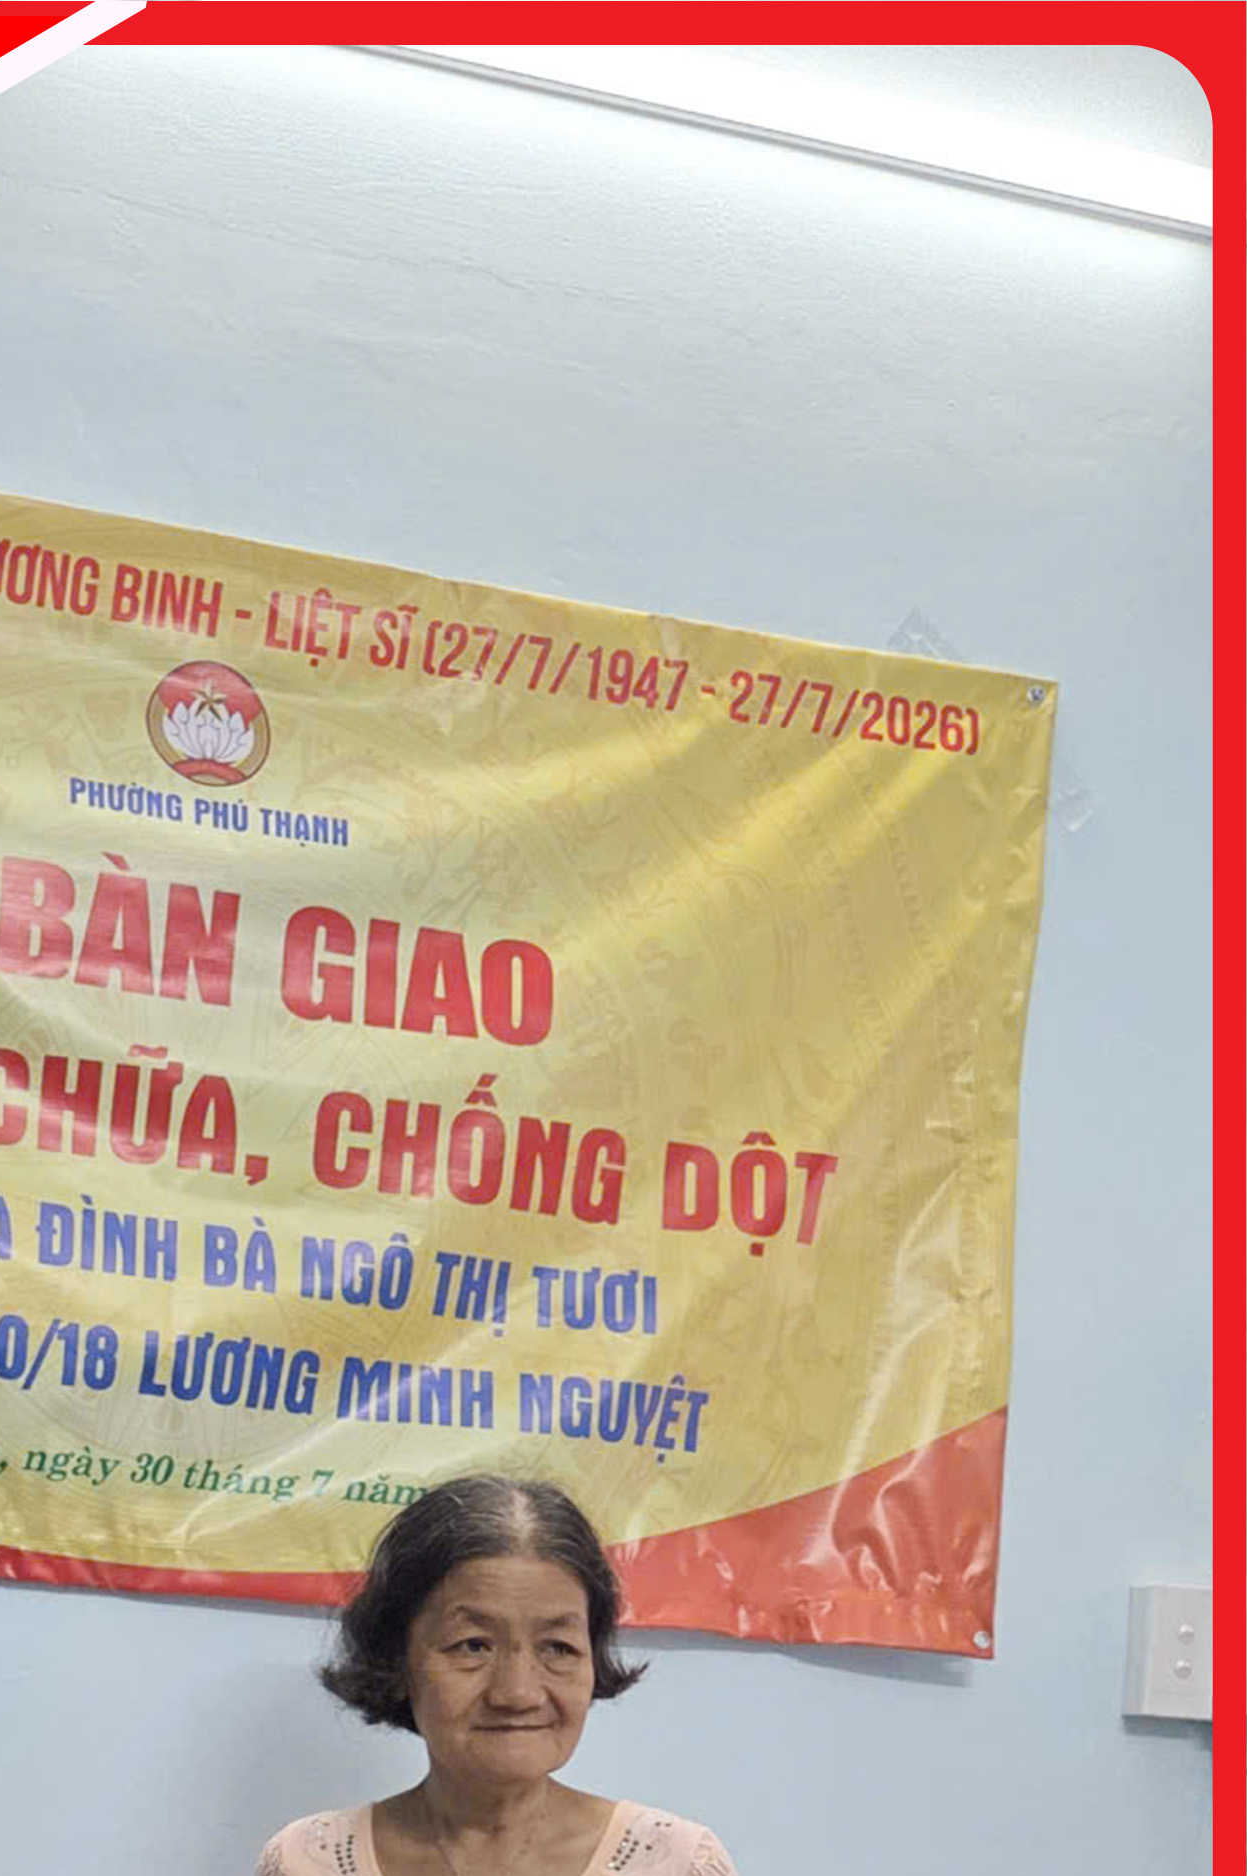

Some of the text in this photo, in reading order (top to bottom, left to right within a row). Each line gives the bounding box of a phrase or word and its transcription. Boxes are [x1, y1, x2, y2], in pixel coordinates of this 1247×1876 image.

[111, 568, 224, 638] BINH
[263, 588, 362, 666] LIỆT
[371, 604, 420, 671] SĨ
[424, 620, 689, 711] (27/7/1947
[729, 670, 979, 755] 27/7/2026)
[70, 777, 348, 847] PHƯỜNG PHÚ THẠNH
[282, 904, 553, 1047] GIAO
[313, 1073, 627, 1225] CHỐNG
[662, 1131, 838, 1257] DỘT
[36, 1194, 178, 1282] ĐÌNH
[203, 1218, 277, 1294] BÀ
[300, 1233, 414, 1310] NGÔ
[432, 1250, 512, 1338] THỊ
[533, 1266, 659, 1334] TƯƠI
[138, 1329, 321, 1416] LƯƠNG
[336, 1357, 495, 1430] MINH
[518, 1372, 709, 1464] NGUYỆT
[21, 1446, 120, 1486] ngày
[130, 1453, 175, 1486] 30
[182, 1459, 301, 1501] tháng
[310, 1469, 336, 1497] 7
[344, 1475, 430, 1506] năm
